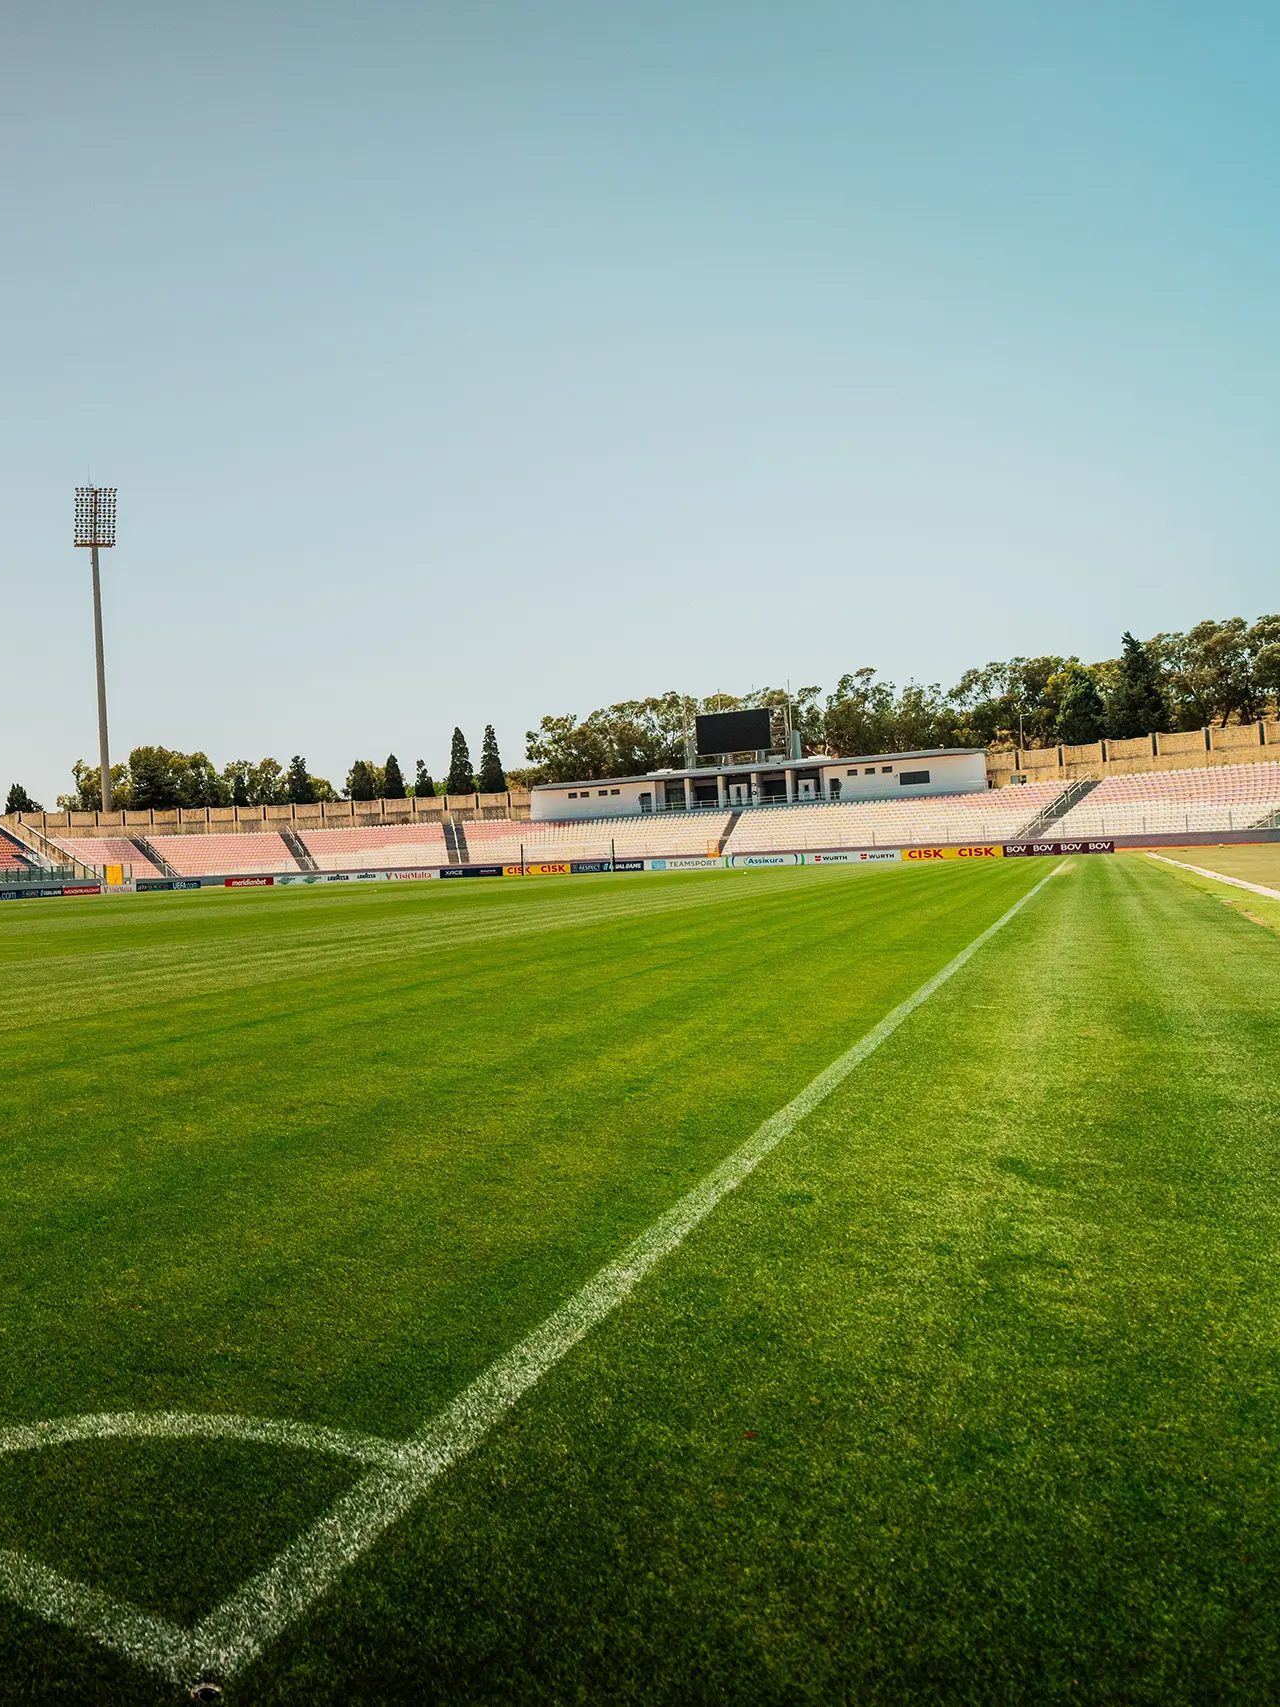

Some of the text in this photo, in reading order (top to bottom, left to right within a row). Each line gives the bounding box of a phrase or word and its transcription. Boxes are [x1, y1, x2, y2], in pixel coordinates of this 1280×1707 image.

[1060, 843, 1082, 851] BOV
[1088, 842, 1110, 850] BOV
[908, 847, 995, 859] CISK CISK
[669, 860, 717, 868] TEAMSPORT
[507, 867, 531, 875] CISK
[540, 864, 566, 873] CISK
[394, 871, 432, 880] VisitMalta
[232, 878, 267, 886] meridianbet
